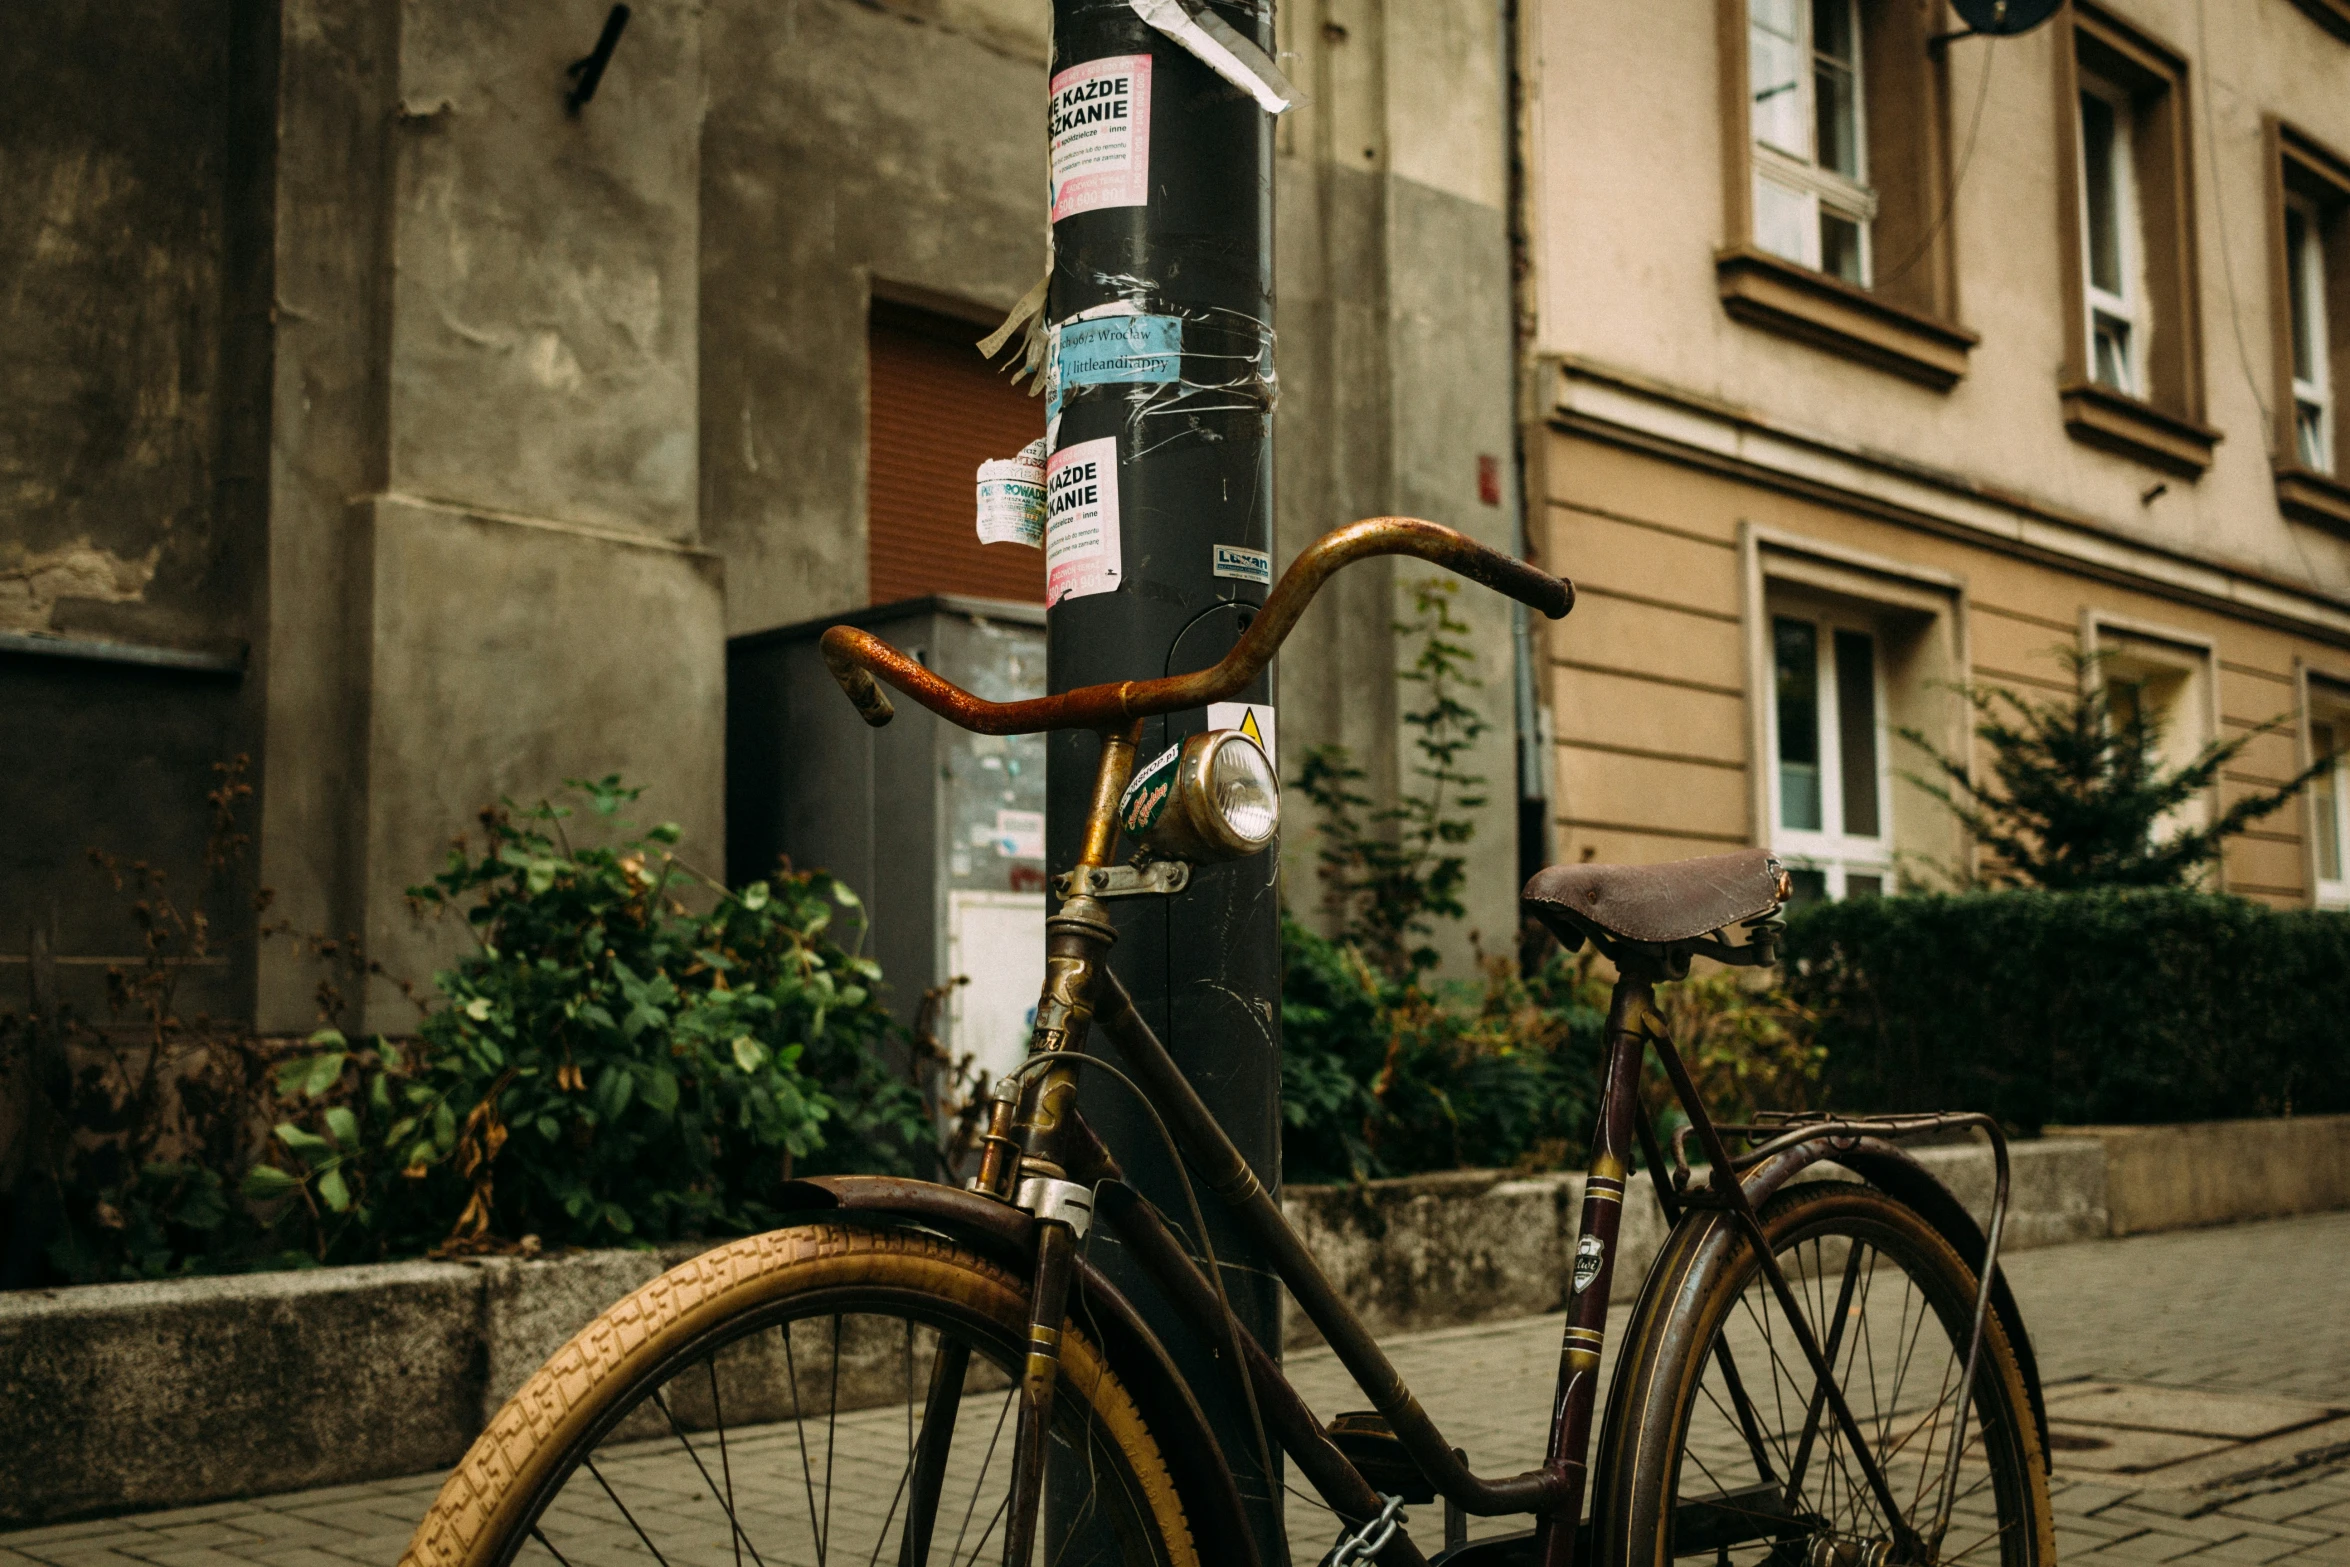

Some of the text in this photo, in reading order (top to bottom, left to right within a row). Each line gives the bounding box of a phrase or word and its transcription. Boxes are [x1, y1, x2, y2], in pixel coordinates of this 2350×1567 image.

[1063, 78, 1128, 109] KAŻDE
[1109, 125, 1127, 133] inne
[1103, 141, 1127, 150] remontu
[1101, 152, 1127, 162] zamianę
[1072, 331, 1094, 348] 96/2
[1049, 462, 1097, 496] KAŻDE
[1082, 510, 1098, 519] inne
